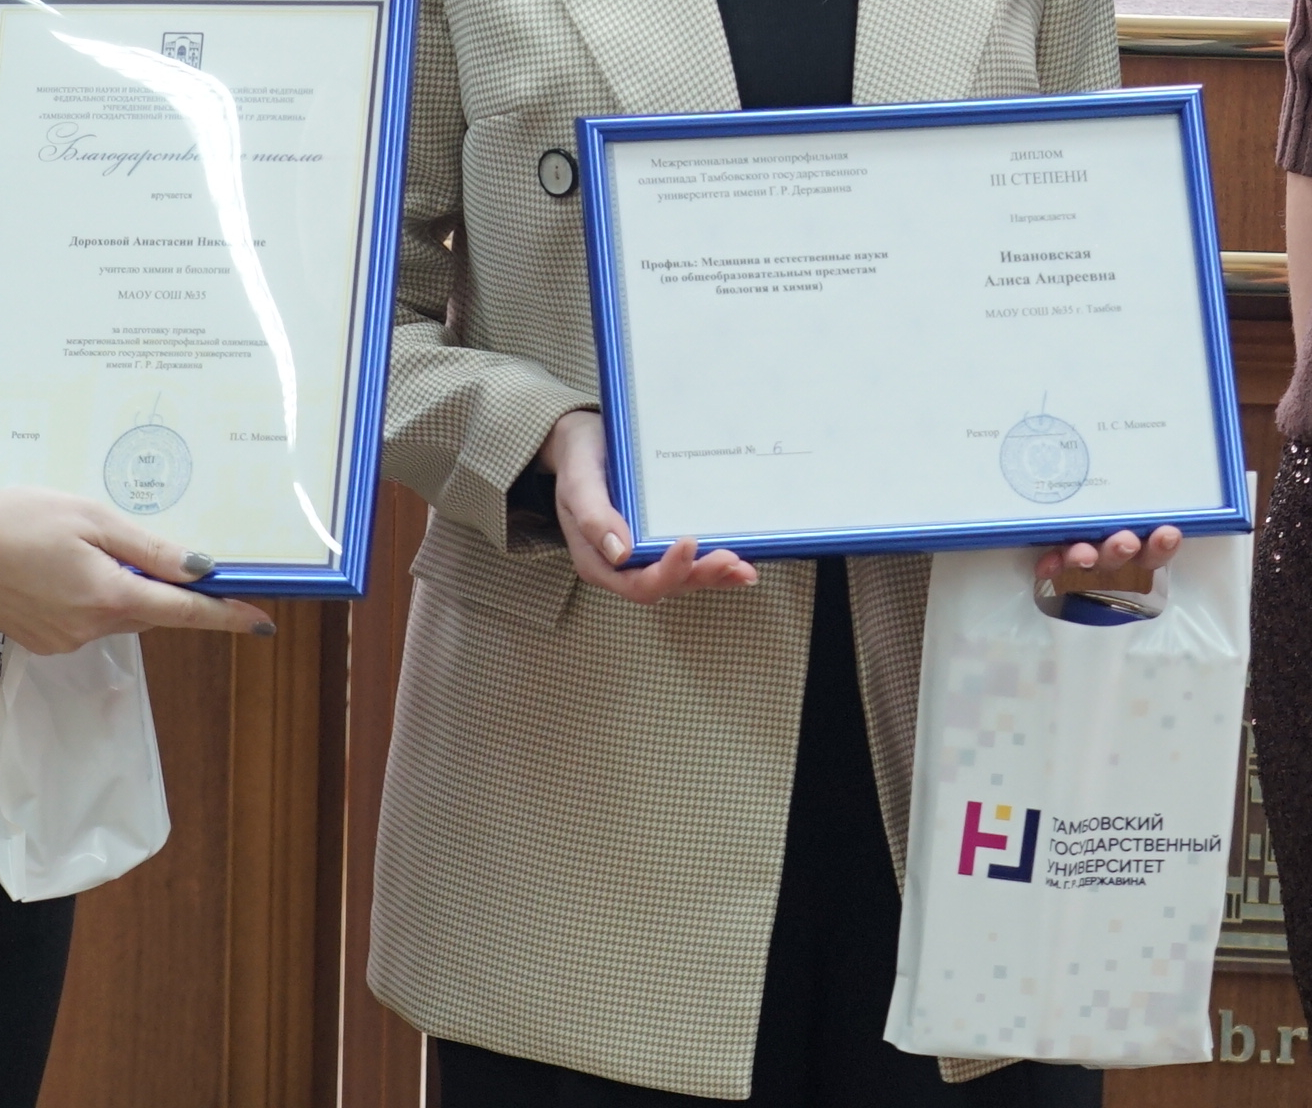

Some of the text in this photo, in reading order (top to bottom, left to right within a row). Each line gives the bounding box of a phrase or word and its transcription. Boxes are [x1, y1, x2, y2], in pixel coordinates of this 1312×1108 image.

[252, 152, 324, 163] письмо
[650, 151, 849, 170] Межрегиональная многопрофильная
[638, 165, 868, 186] олимпиада Тамбовского государственного
[989, 168, 1089, 187] III СТЕПЕНИ
[150, 192, 193, 201] вручается
[657, 190, 730, 203] университета
[733, 188, 767, 198] имени
[792, 183, 853, 197] Державина
[1009, 212, 1077, 225] Награждается
[68, 236, 130, 248] Дороховой
[133, 237, 194, 247] Анастасии
[640, 250, 889, 272] Профиль: Медицина и естественные науки
[999, 249, 1092, 263] Ивановская
[98, 265, 141, 276] учителю
[142, 266, 174, 274] химии
[185, 264, 231, 275] биологии
[659, 264, 877, 285] (по общеобразовательным предметам
[984, 270, 1116, 287] Алиса Андреевна
[715, 280, 824, 296] биология и химия)
[117, 290, 207, 300] МАОУ СОШ №35
[985, 307, 1019, 319] МАОУ
[1021, 305, 1049, 317] СОШ
[1050, 304, 1074, 316] №35
[1086, 302, 1122, 314] Тамбов
[111, 326, 206, 336] за подготовку призера
[66, 336, 141, 347] межрегиональной
[142, 337, 220, 347] многопрофильной
[63, 348, 252, 360] Тамбовского государственного университета
[155, 361, 203, 371] Державина
[1124, 419, 1167, 430] Моисеев
[11, 429, 41, 441] Ректор
[966, 427, 1000, 439] Ректор
[1059, 439, 1079, 450] МП
[138, 454, 156, 464] МП
[655, 446, 743, 460] Регистрационный
[133, 478, 165, 488] Тамбов
[1052, 812, 1164, 835] ТАМБОВСКИЙ
[1049, 834, 1222, 856] ГОСУДАРСТВЕННЫЙ
[1047, 858, 1166, 877] УНИВЕРСИТЕТ
